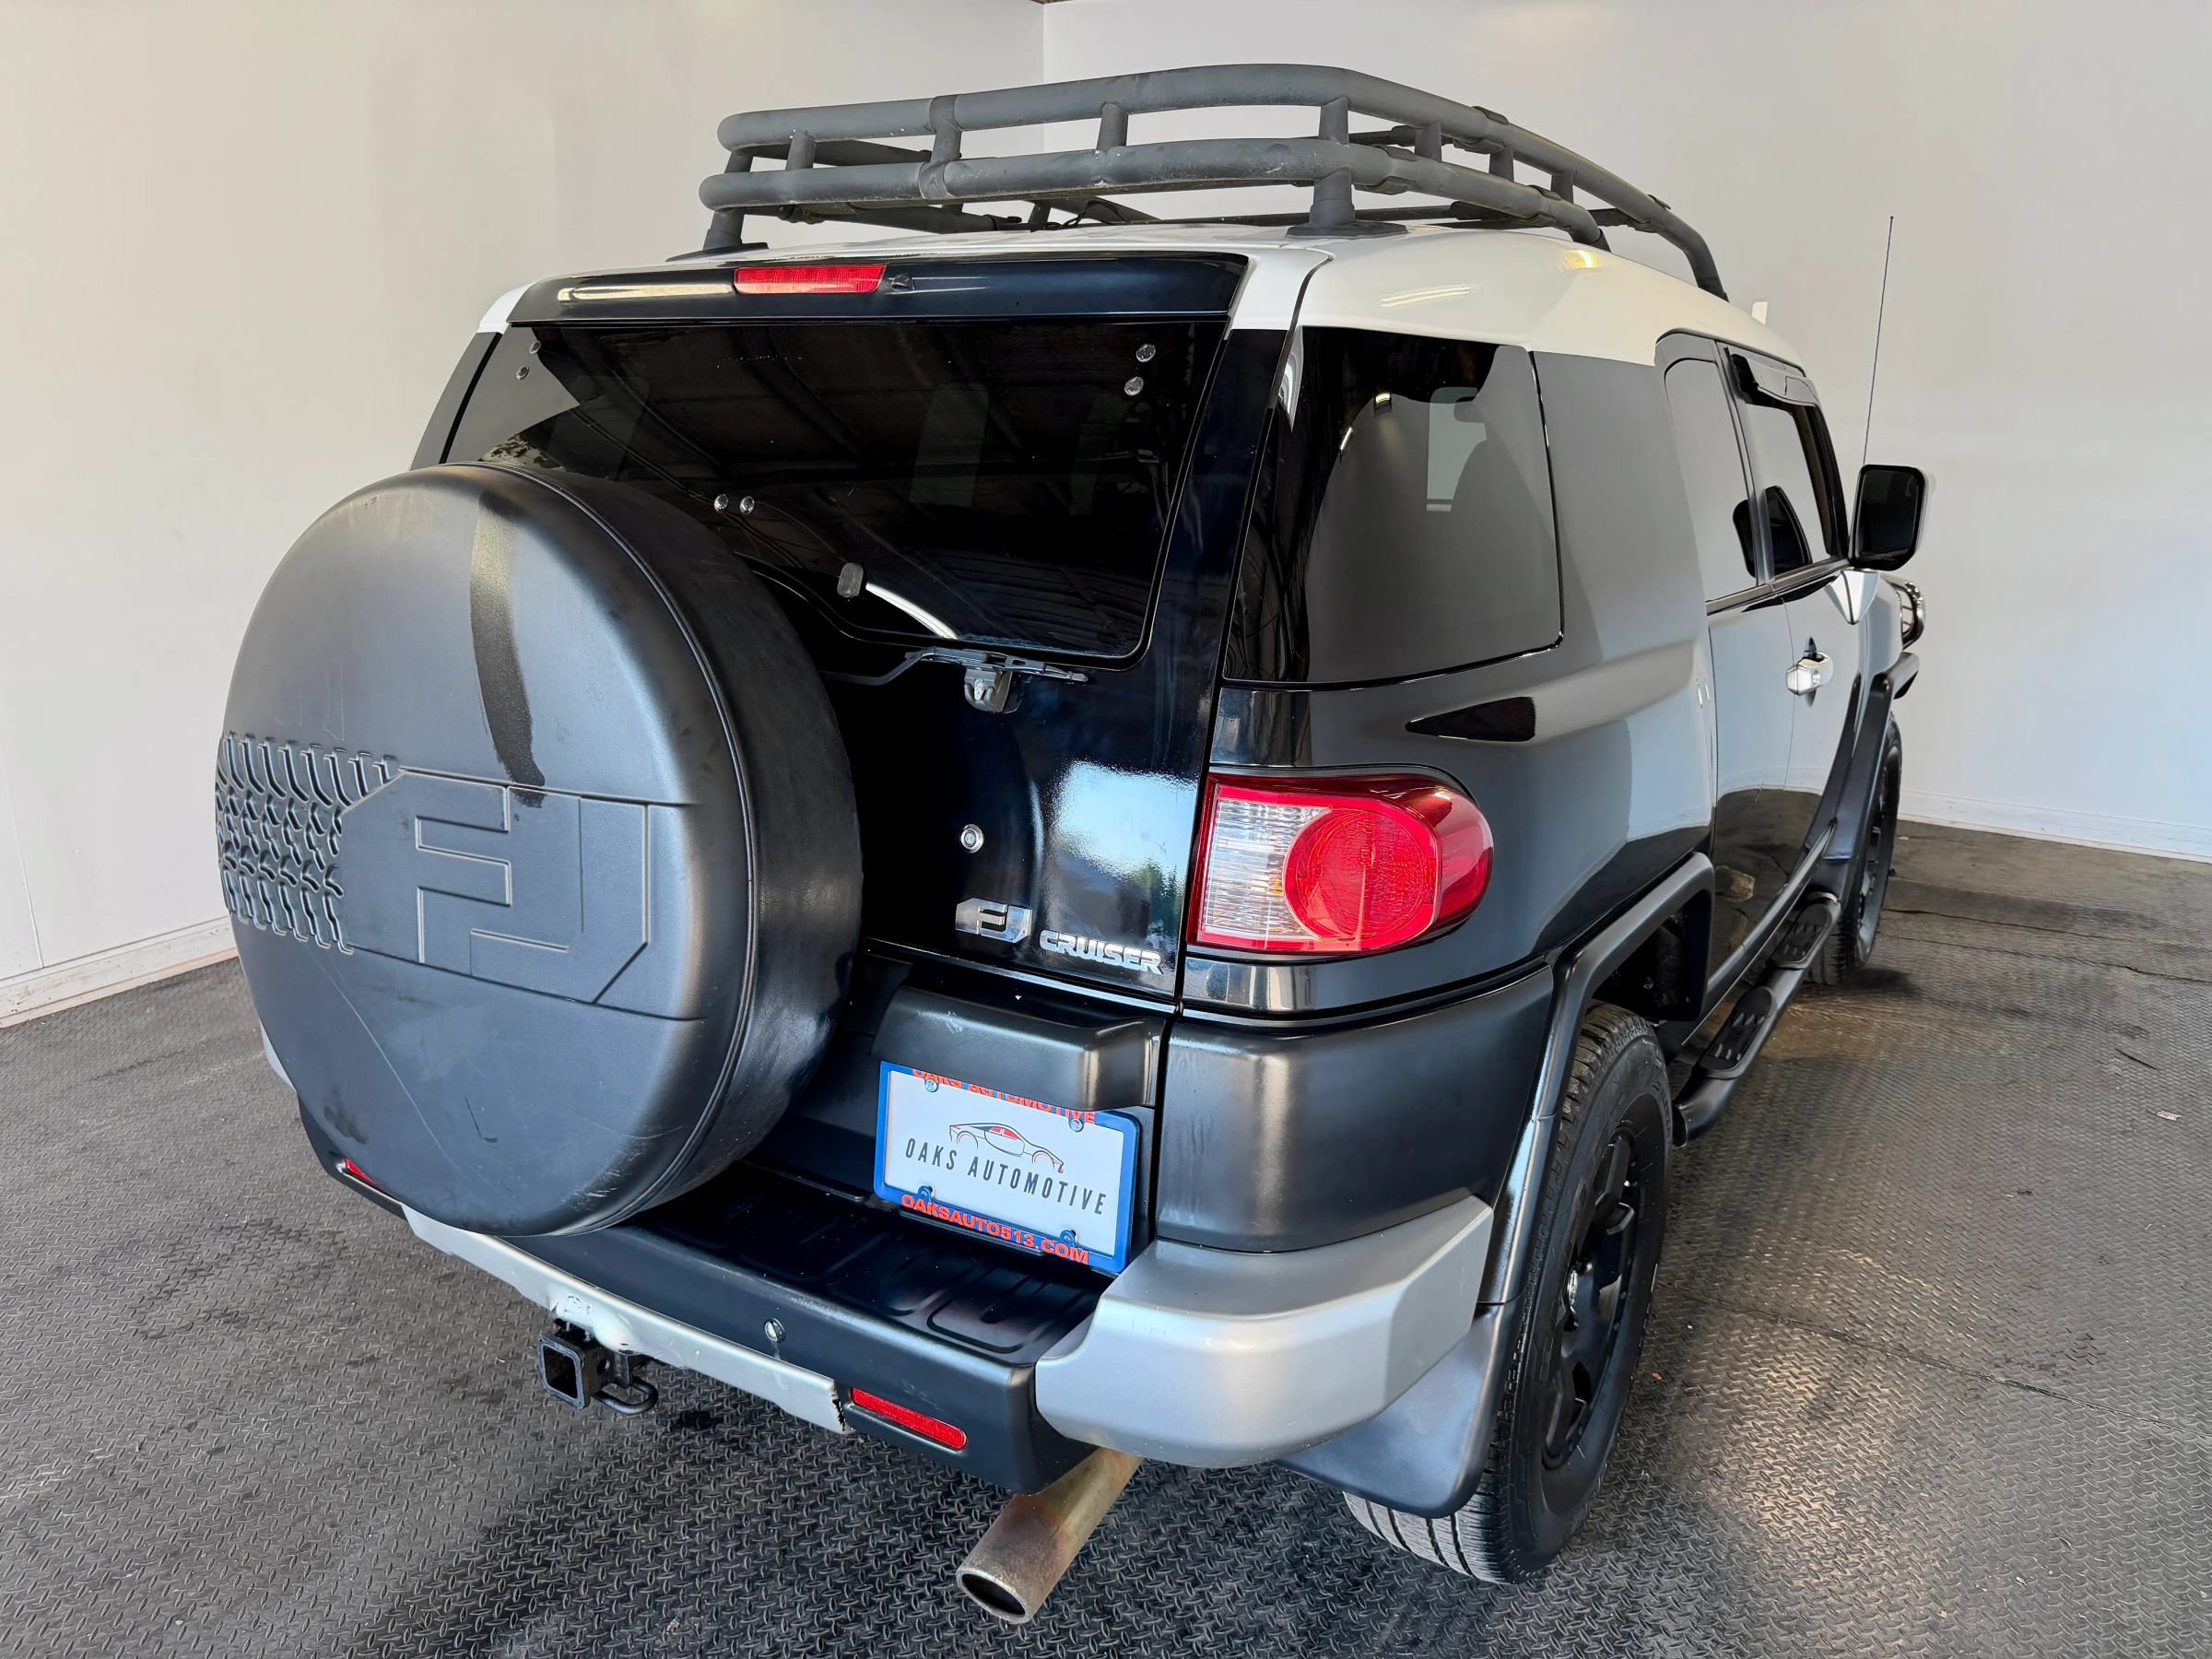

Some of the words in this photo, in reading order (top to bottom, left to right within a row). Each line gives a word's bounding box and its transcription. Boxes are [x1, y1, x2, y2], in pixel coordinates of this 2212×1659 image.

[339, 768, 651, 1005] FJ
[955, 897, 1032, 944] FJ
[1039, 929, 1164, 974] CRUISER
[905, 1137, 958, 1171] OAKS
[967, 1156, 1108, 1216] AUTOMOTIVE
[900, 1194, 1089, 1265] OAKSAUTO513.COM
